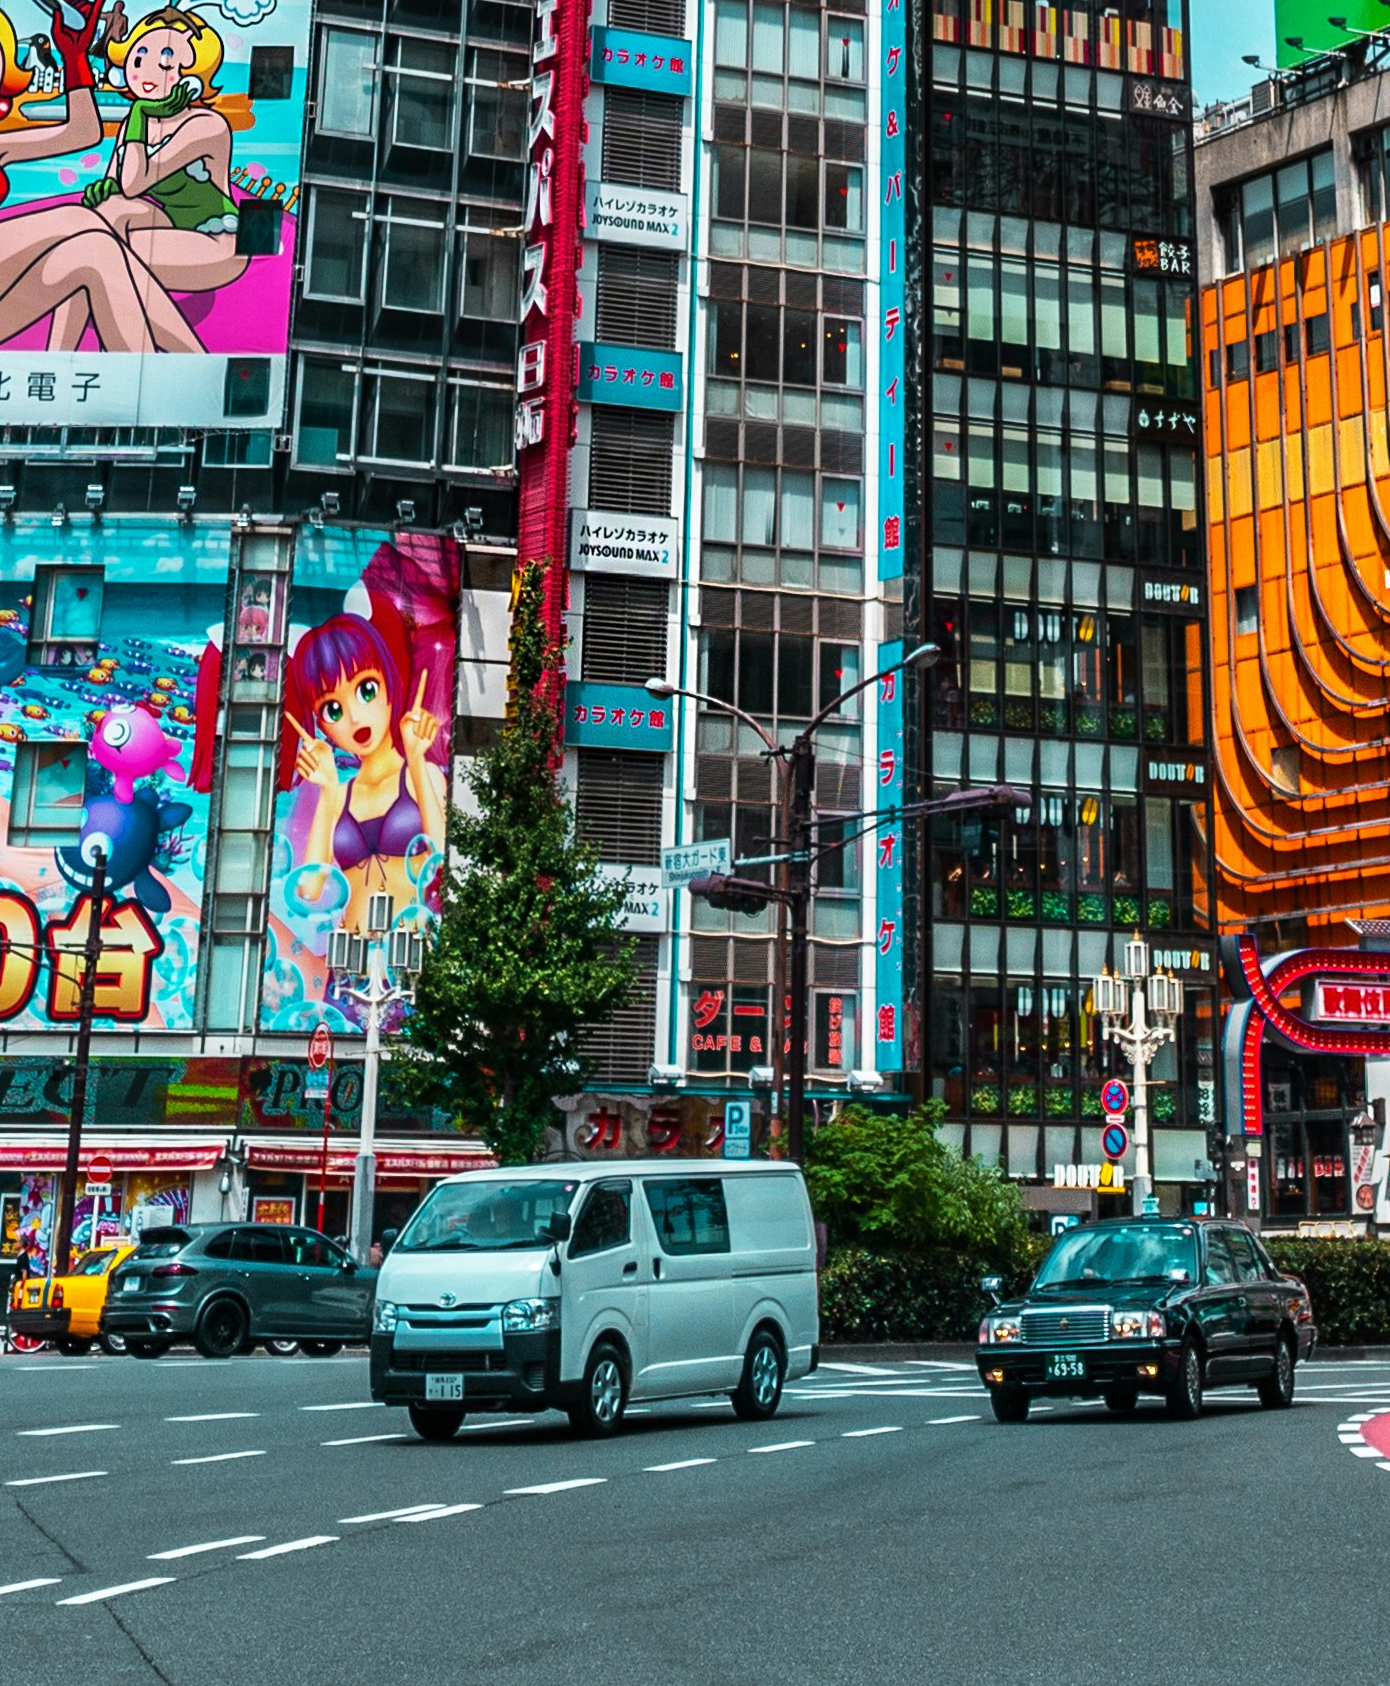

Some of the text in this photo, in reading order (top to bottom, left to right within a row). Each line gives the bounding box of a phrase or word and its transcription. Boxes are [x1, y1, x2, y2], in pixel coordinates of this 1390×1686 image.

[600, 46, 685, 75] カラオケ館
[593, 195, 679, 219] ハイレゾカラオケ
[592, 213, 645, 231] JOYSOUND
[646, 220, 669, 234] MAX
[1159, 241, 1191, 260] 餃子
[1160, 258, 1191, 275] BAR
[587, 364, 675, 390] カラオケ館
[579, 524, 670, 545] ハイレゾカラオケ
[577, 543, 634, 561] JOYSOUND
[635, 548, 659, 562] MAX
[1144, 581, 1199, 605] DOUTOR
[572, 702, 666, 730] カラオケ館
[1148, 761, 1205, 784] DOUTOR
[664, 846, 727, 871] 新宿大ガード東
[1153, 949, 1210, 971] DOUTOR
[691, 1033, 741, 1052] CAFE
[749, 1035, 763, 1053] &
[728, 1106, 745, 1135] P
[1054, 1361, 1084, 1377] 69-58
